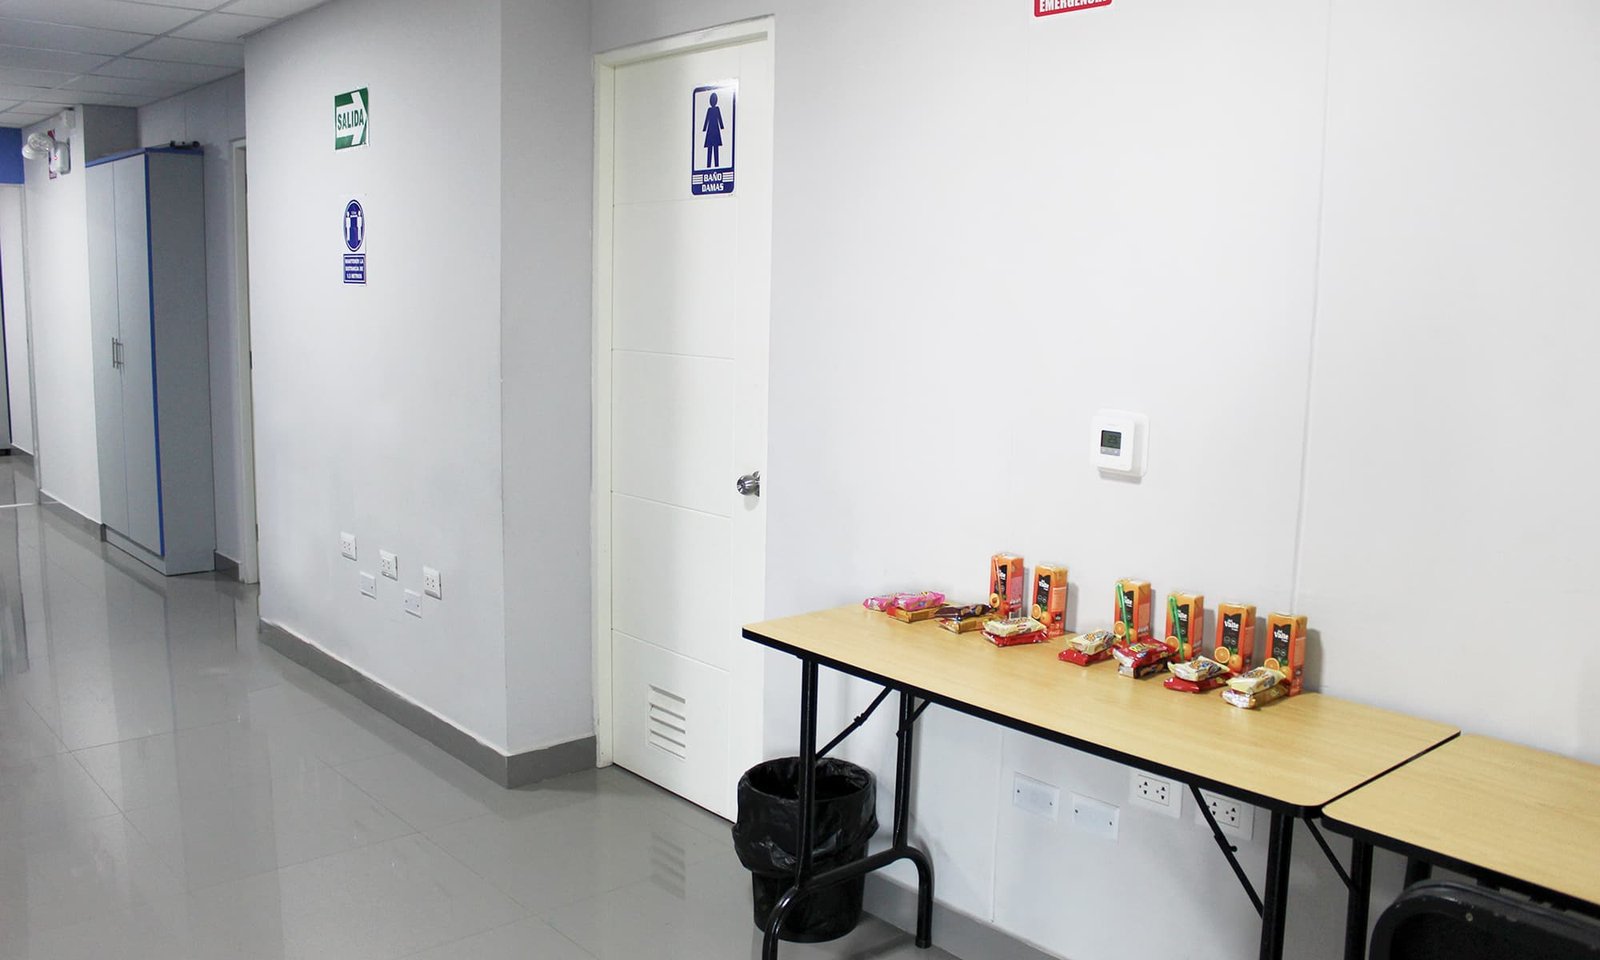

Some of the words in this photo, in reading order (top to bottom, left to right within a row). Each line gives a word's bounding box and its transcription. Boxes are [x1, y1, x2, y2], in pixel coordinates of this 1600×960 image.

[1040, 0, 1107, 12] EMERGE
[337, 108, 364, 131] SALIDA
[703, 172, 722, 182] BAÑO
[701, 183, 724, 192] DAMAS
